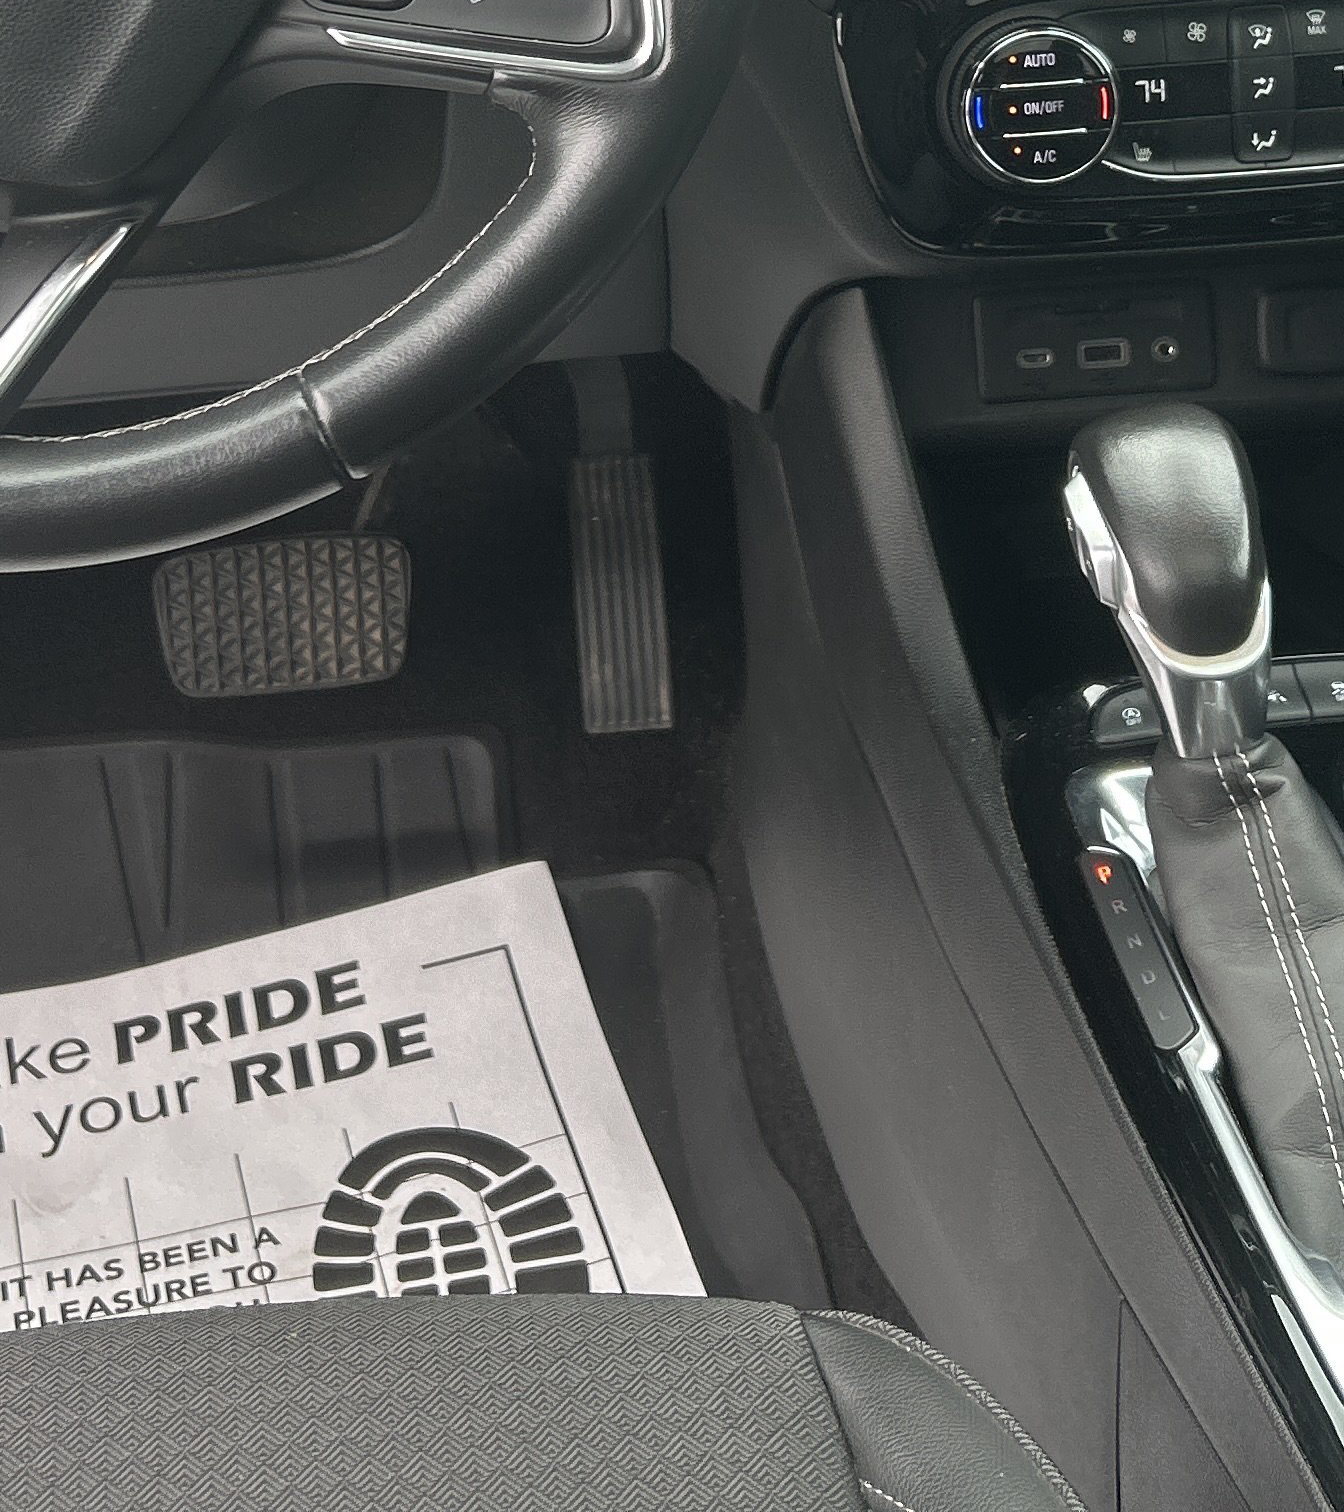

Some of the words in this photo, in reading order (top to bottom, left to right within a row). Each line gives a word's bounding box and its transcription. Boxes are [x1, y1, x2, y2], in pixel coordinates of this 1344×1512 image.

[1307, 24, 1327, 36] MAX
[1023, 52, 1056, 69] AUTO
[1134, 78, 1166, 103] 74
[1023, 100, 1064, 116] ON/OFF
[1033, 148, 1056, 165] A/C
[1097, 865, 1113, 885] P
[1112, 899, 1127, 915] R
[1127, 934, 1143, 949] N
[1141, 970, 1156, 985] D
[113, 960, 366, 1063] PRIDE
[1159, 1010, 1171, 1021] L
[32, 1073, 201, 1158] your
[230, 1014, 435, 1105] RIDE
[0, 1275, 32, 1301] IT
[46, 1258, 124, 1291] HAS
[139, 1232, 239, 1273] BEEN
[254, 1226, 282, 1249] A
[14, 1273, 213, 1329] PLEASURE
[222, 1261, 278, 1288] TO
